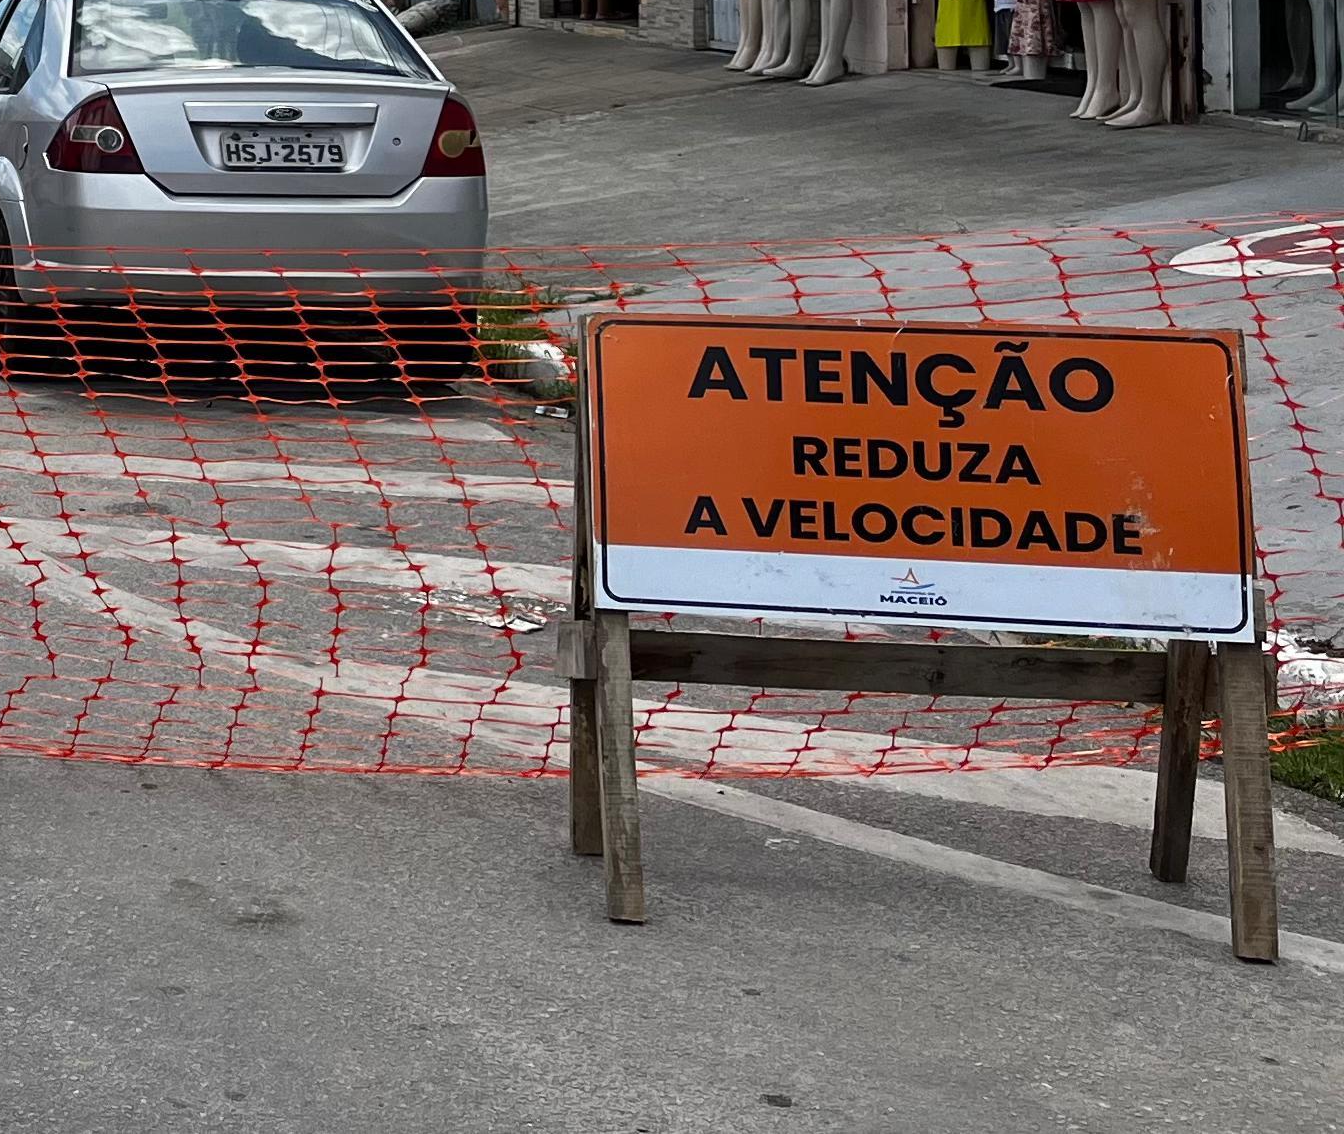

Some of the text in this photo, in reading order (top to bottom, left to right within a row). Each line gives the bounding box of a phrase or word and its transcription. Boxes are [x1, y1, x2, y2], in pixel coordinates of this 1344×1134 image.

[687, 341, 1114, 428] ATENÇÃO
[793, 436, 1041, 486] REDUZA
[684, 496, 1143, 556] A VELOCIDADE
